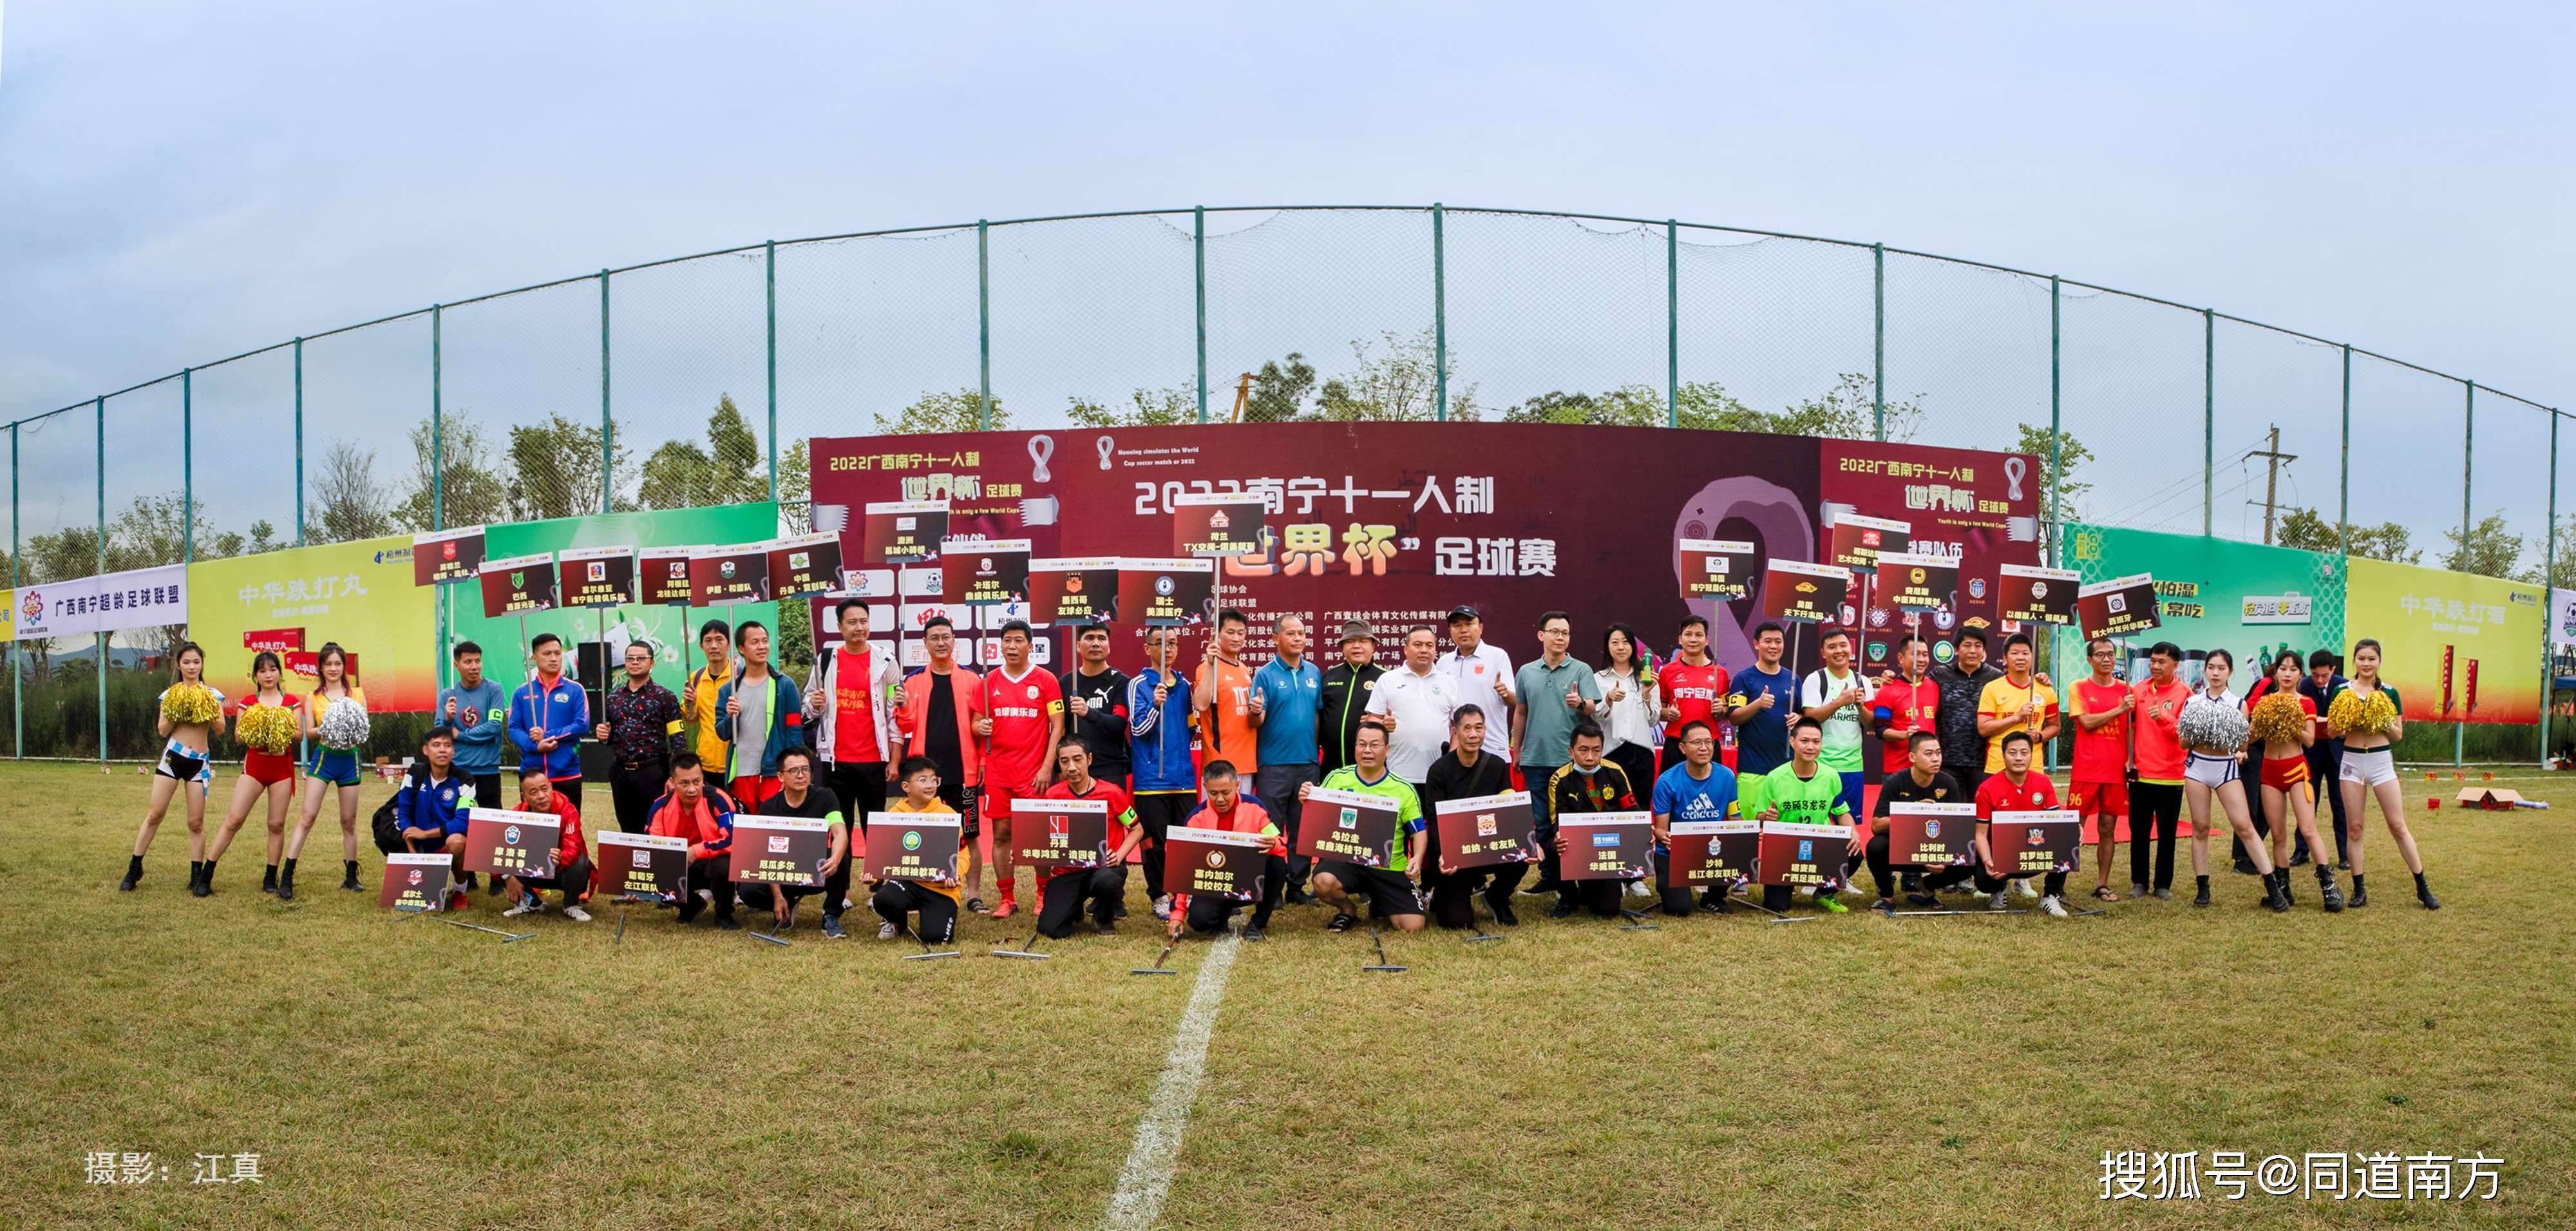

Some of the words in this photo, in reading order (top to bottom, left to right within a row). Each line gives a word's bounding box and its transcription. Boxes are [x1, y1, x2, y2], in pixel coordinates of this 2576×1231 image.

[830, 451, 980, 471] 2022广西南宁十一人制
[1840, 457, 1974, 483] 2022广西南宁十一人制
[902, 472, 981, 501] 世界杯
[986, 484, 1023, 498] 足球赛
[1905, 484, 1975, 513] 世界杯
[1978, 499, 2009, 515] 足球赛
[1210, 531, 1229, 541] 荷兰
[386, 548, 414, 560] 梧州制
[1435, 537, 1557, 577] 足球赛
[793, 573, 810, 582] 中国
[239, 572, 368, 607] 中华跌打丸
[973, 580, 999, 590] 卡塔尔
[55, 585, 180, 617] 广西南宁超龄足球联盟
[513, 591, 527, 601] 巴西
[1061, 595, 1088, 605] 墨西哥
[1155, 596, 1174, 606] 瑞士
[1057, 606, 1092, 615] 友球必应
[2167, 601, 2203, 618] 常吃
[2400, 593, 2506, 625] 中华跌打酒
[1324, 611, 1453, 621] 广西壹球会体育文化传媒有限
[2108, 613, 2132, 625] 西班牙
[251, 641, 289, 651] 中华跌打丸
[2069, 792, 2082, 806] 96
[1681, 810, 1719, 819] adidas
[1331, 830, 1360, 844] 乌拉圭
[1050, 839, 1069, 848] 丹麦
[1461, 839, 1517, 855] 加纳·老友队
[1920, 843, 1946, 852] 比利时
[901, 855, 920, 865] 德国
[1598, 850, 1616, 861] 法国
[2019, 851, 2053, 861] 克罗地亚
[759, 859, 795, 870] 厄瓜多尔
[1705, 859, 1723, 868] 沙特
[628, 871, 654, 882] 葡萄牙
[882, 866, 938, 877] 广西领袖教育
[1195, 868, 1234, 881] 塞内加尔
[1688, 868, 1740, 879] 邕江老友联队
[624, 881, 659, 892] 左江联队
